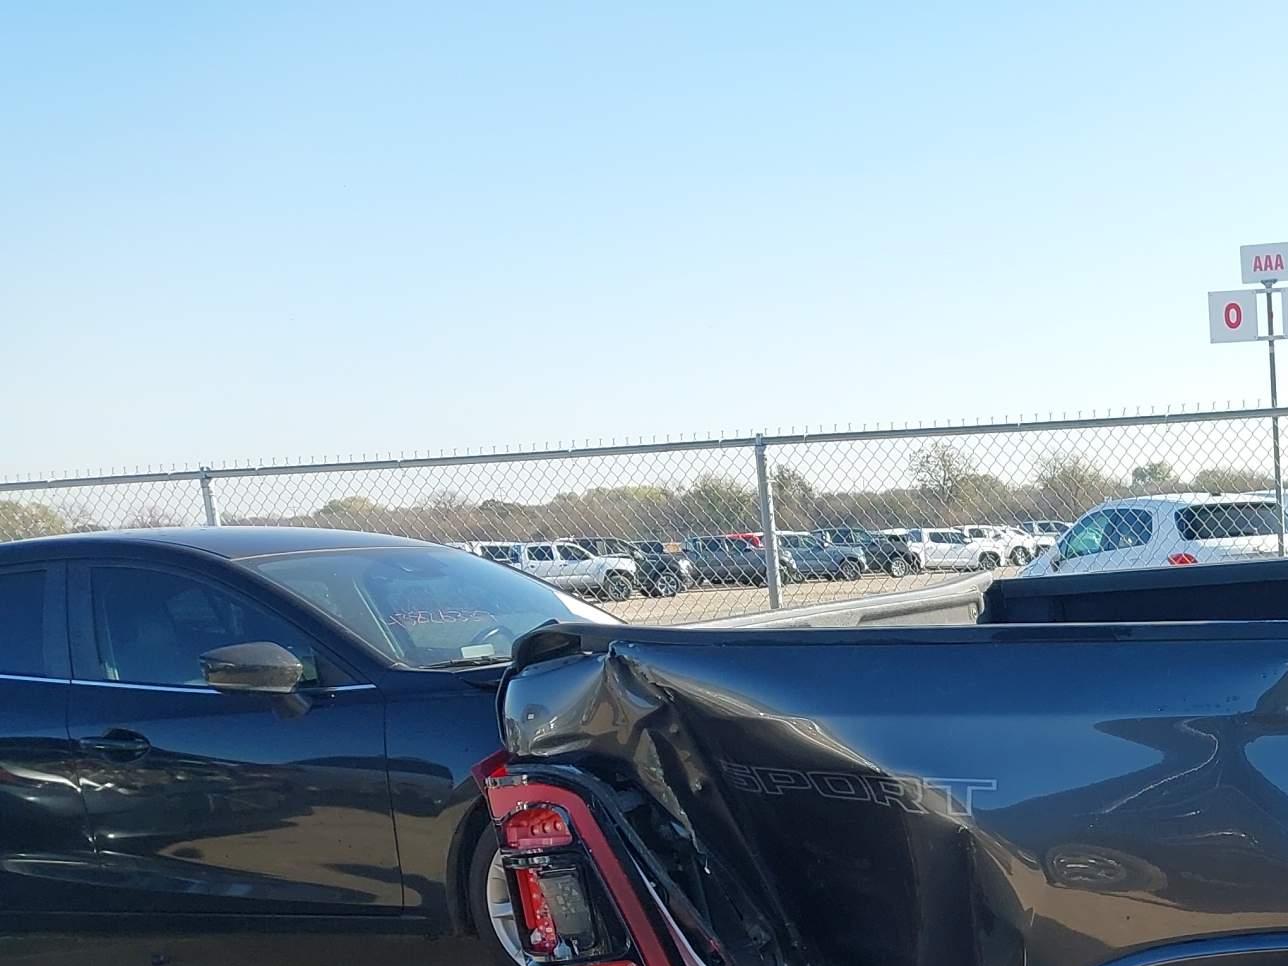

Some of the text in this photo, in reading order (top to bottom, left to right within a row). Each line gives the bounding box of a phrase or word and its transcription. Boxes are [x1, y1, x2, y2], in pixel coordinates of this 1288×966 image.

[1253, 254, 1284, 272] AAA
[1224, 302, 1242, 329] O
[720, 759, 998, 818] SPORT
